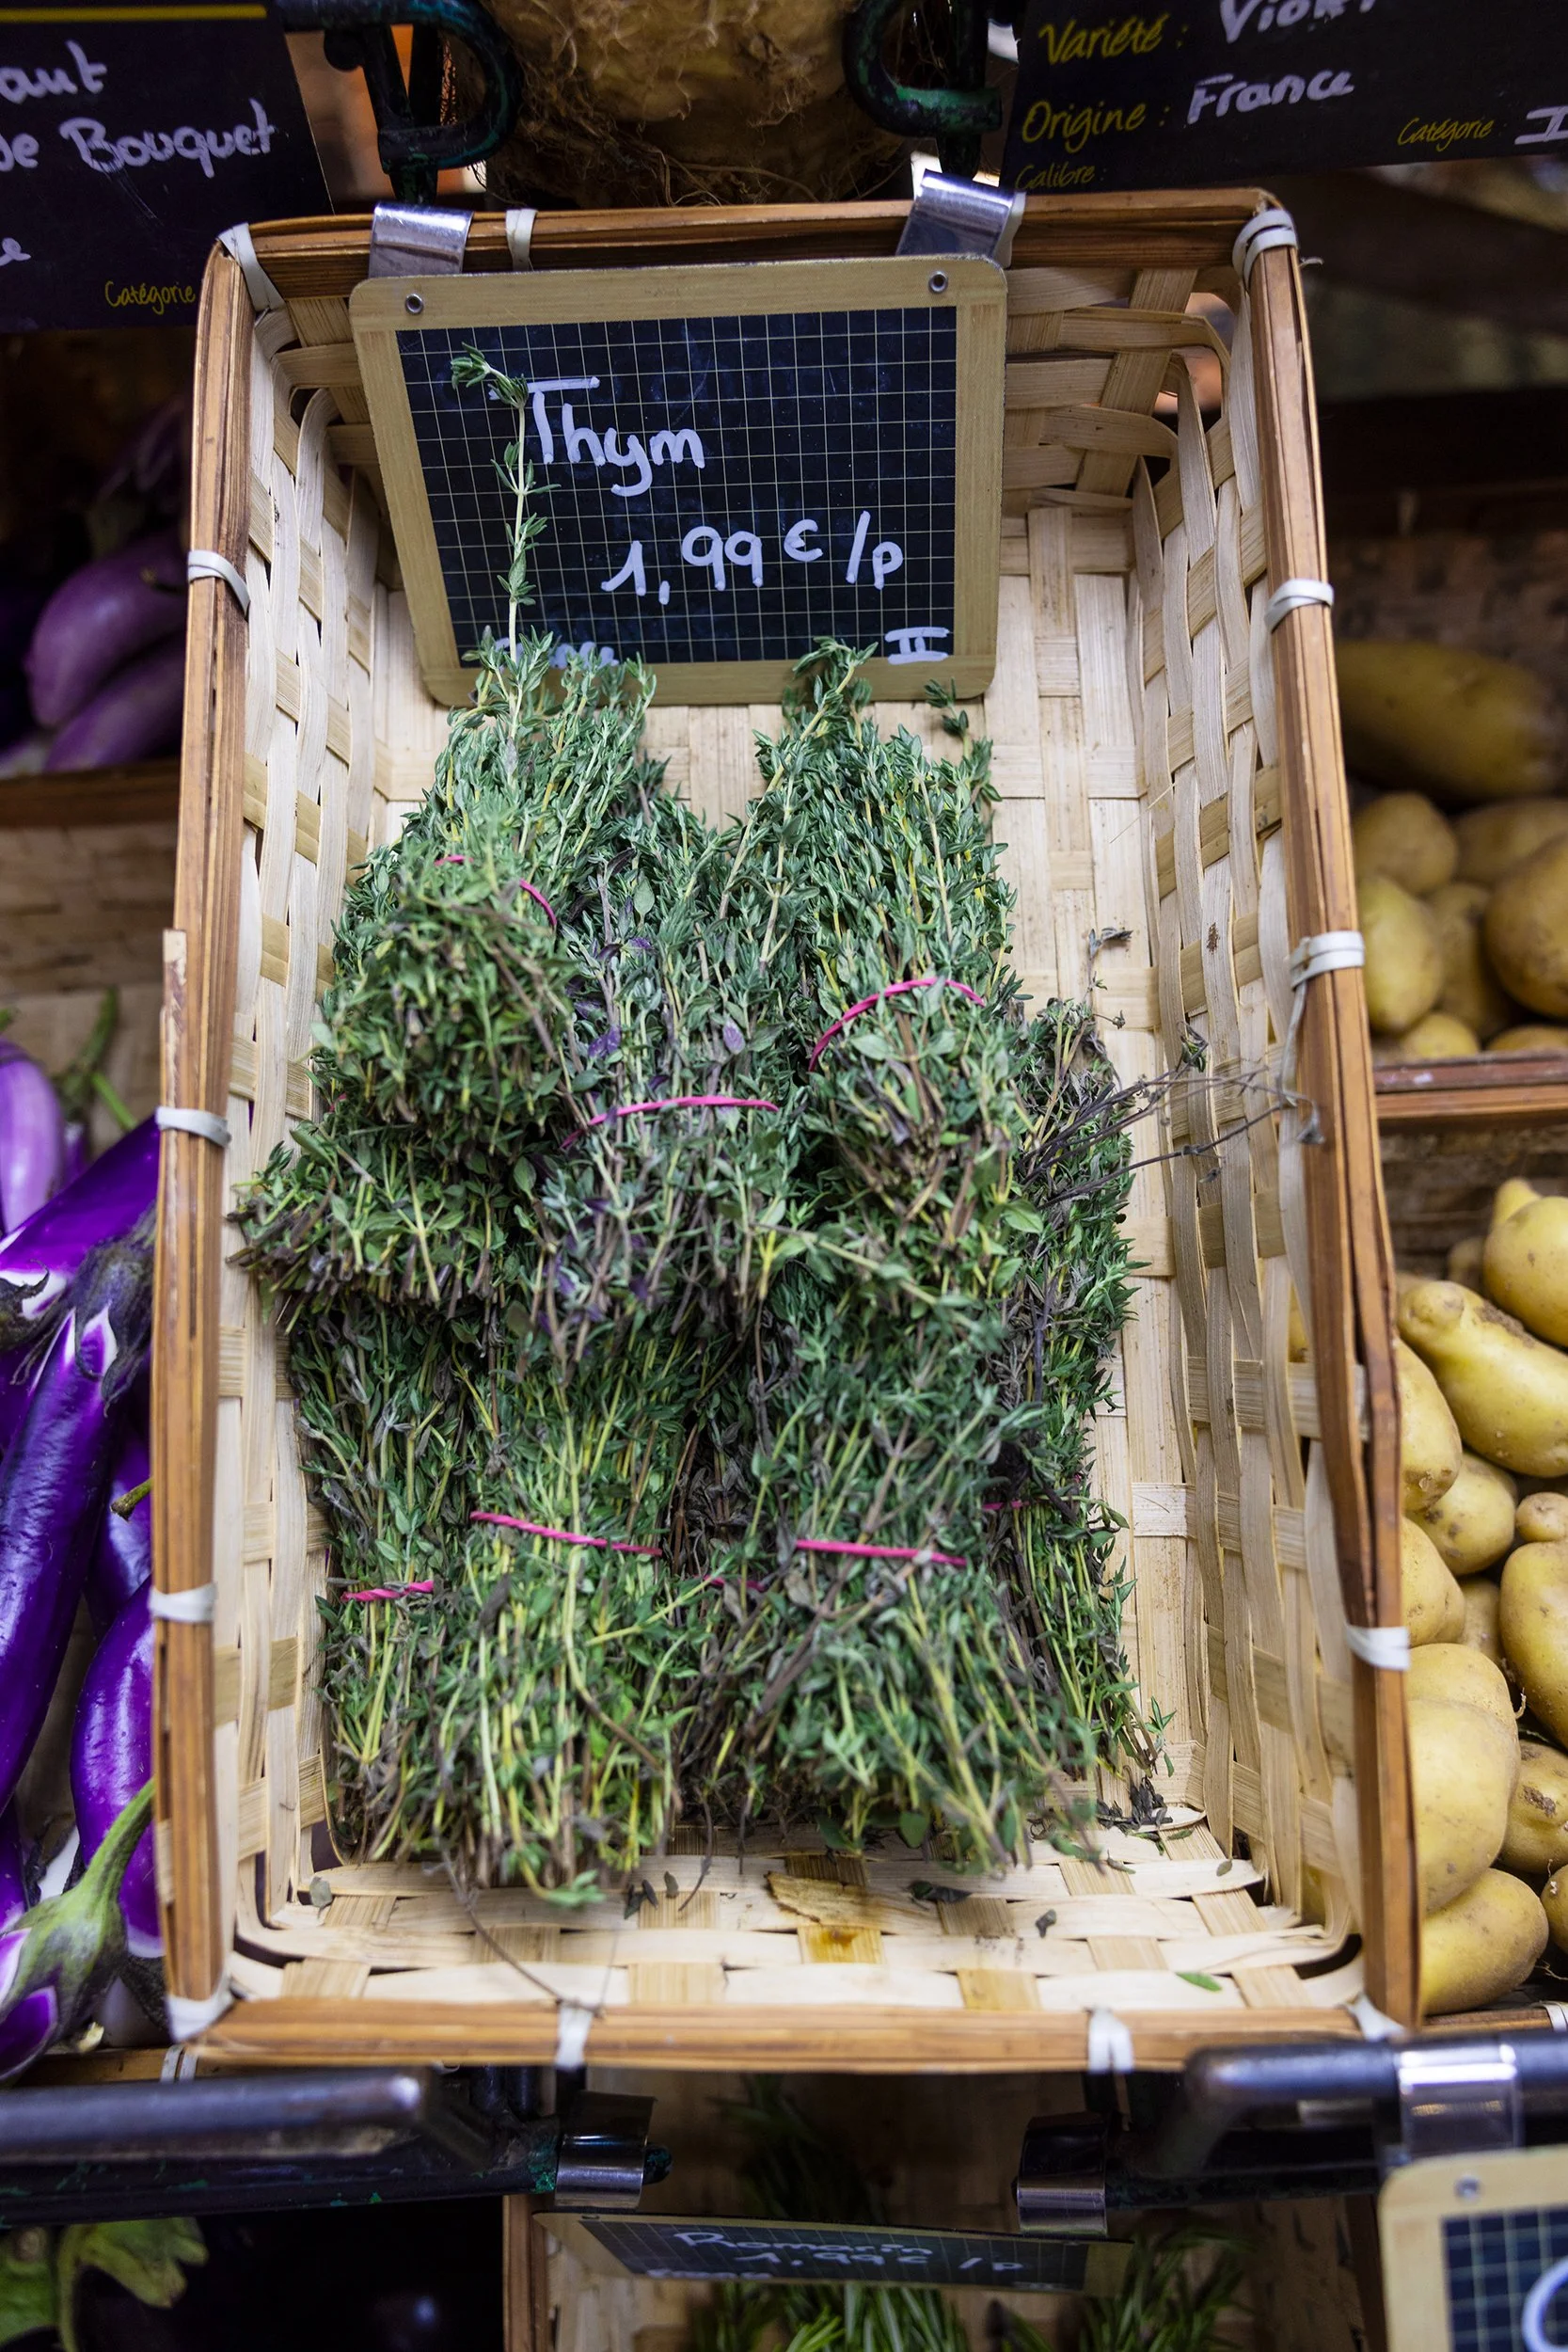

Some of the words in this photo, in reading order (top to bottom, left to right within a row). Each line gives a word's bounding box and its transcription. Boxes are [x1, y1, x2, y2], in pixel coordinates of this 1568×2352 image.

[1038, 12, 1170, 66] Variété
[1022, 101, 1146, 153] Origine
[1186, 70, 1355, 125] France
[59, 98, 277, 179] Bouquet
[1015, 162, 1095, 189] Calibre
[104, 280, 196, 314] Catégorie
[488, 376, 705, 498] Thym
[884, 626, 950, 665] II
[673, 2231, 933, 2255] Romarin
